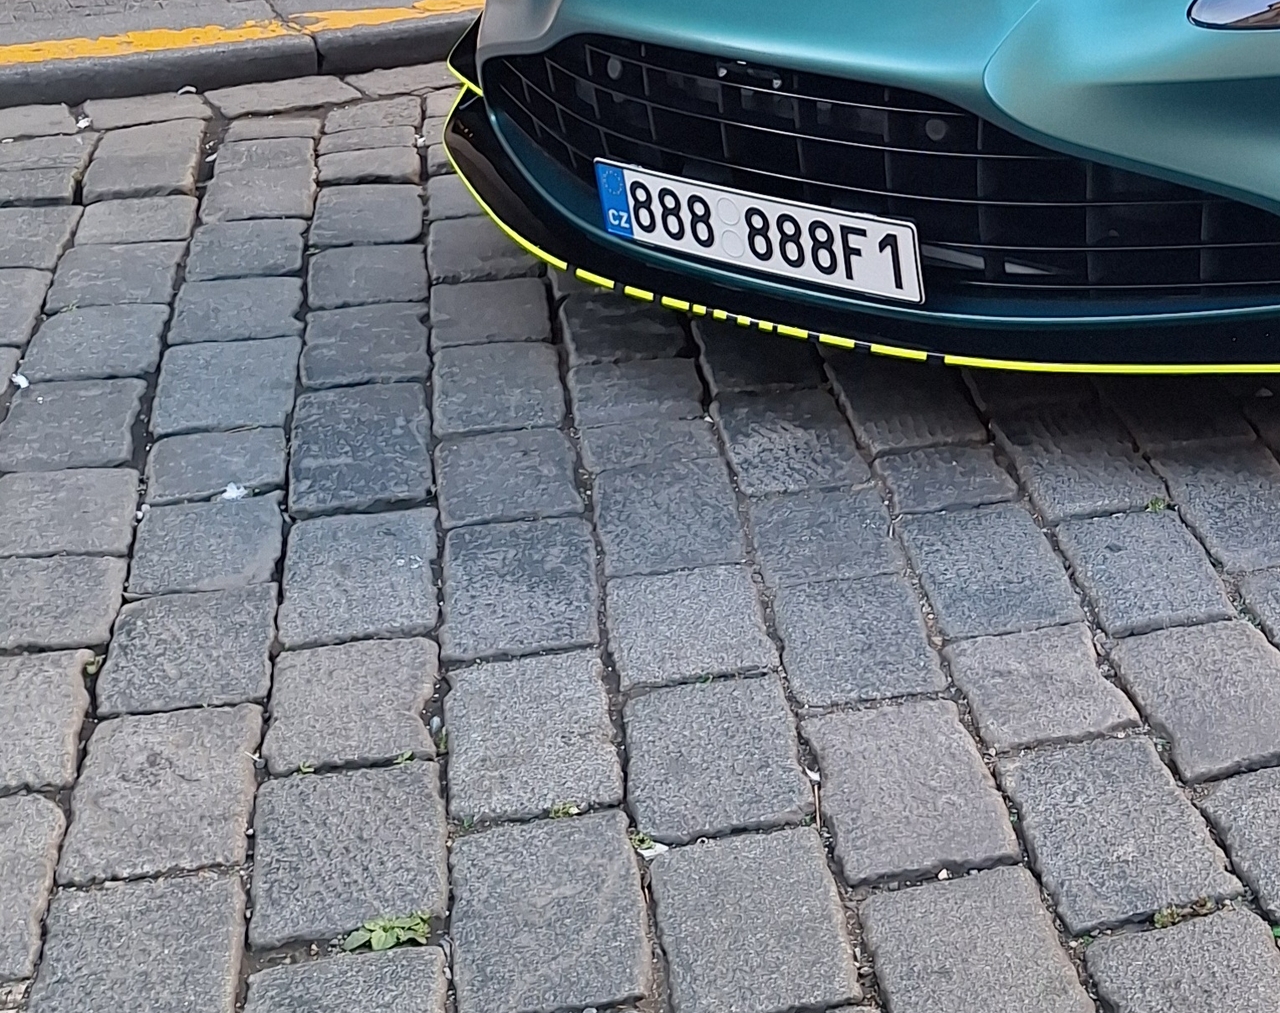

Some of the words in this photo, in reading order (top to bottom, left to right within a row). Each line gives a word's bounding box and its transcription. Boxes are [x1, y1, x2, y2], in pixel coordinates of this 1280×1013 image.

[607, 208, 631, 229] CZ
[629, 179, 716, 248] 888
[744, 205, 905, 291] 888F1
